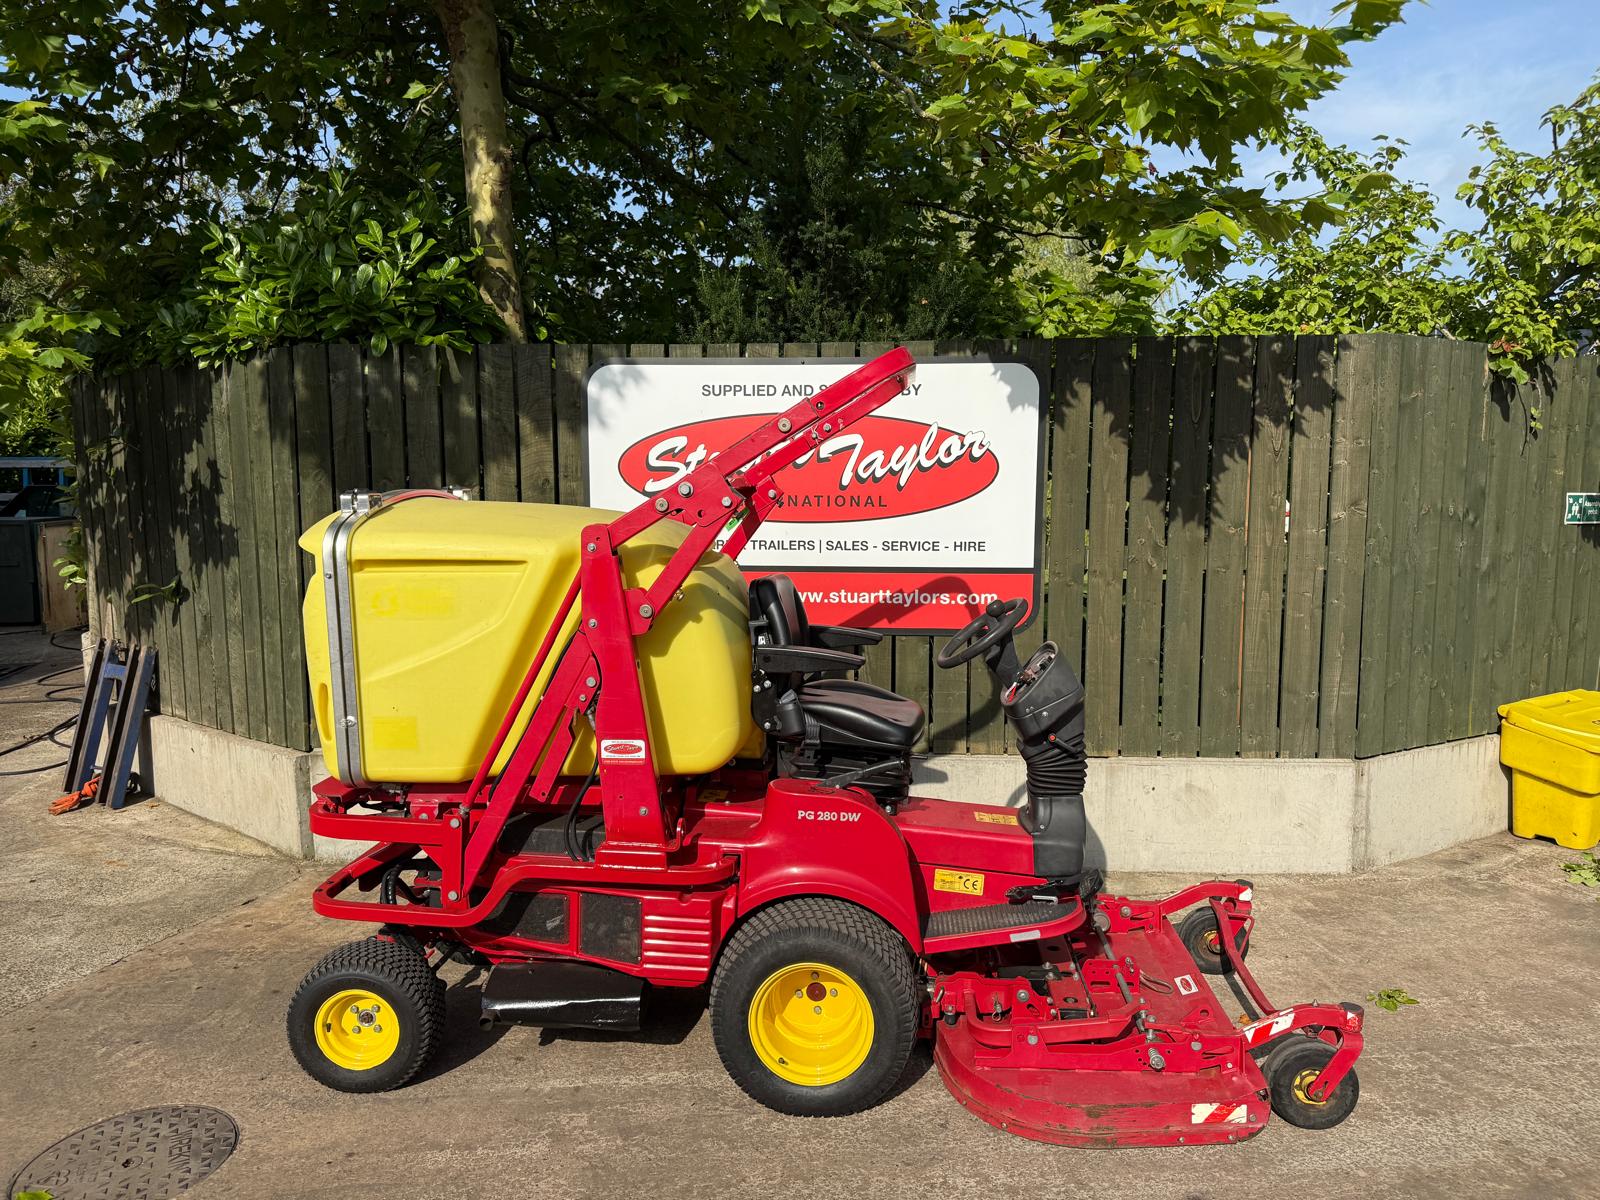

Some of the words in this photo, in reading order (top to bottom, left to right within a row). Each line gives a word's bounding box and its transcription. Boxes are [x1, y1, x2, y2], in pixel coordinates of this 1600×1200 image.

[701, 384, 777, 397] SUPPLIED
[781, 384, 814, 397] AND
[817, 421, 991, 490] Taylor
[787, 495, 888, 508] NATIONAL
[751, 540, 815, 551] TRAILERS
[825, 540, 869, 551] SALES
[881, 541, 940, 552] SERVICE
[953, 541, 986, 552] HIRE
[797, 588, 998, 608] ww.stuarttaylors.com
[797, 810, 815, 820] PG
[816, 811, 838, 821] 280
[839, 812, 861, 822] DW
